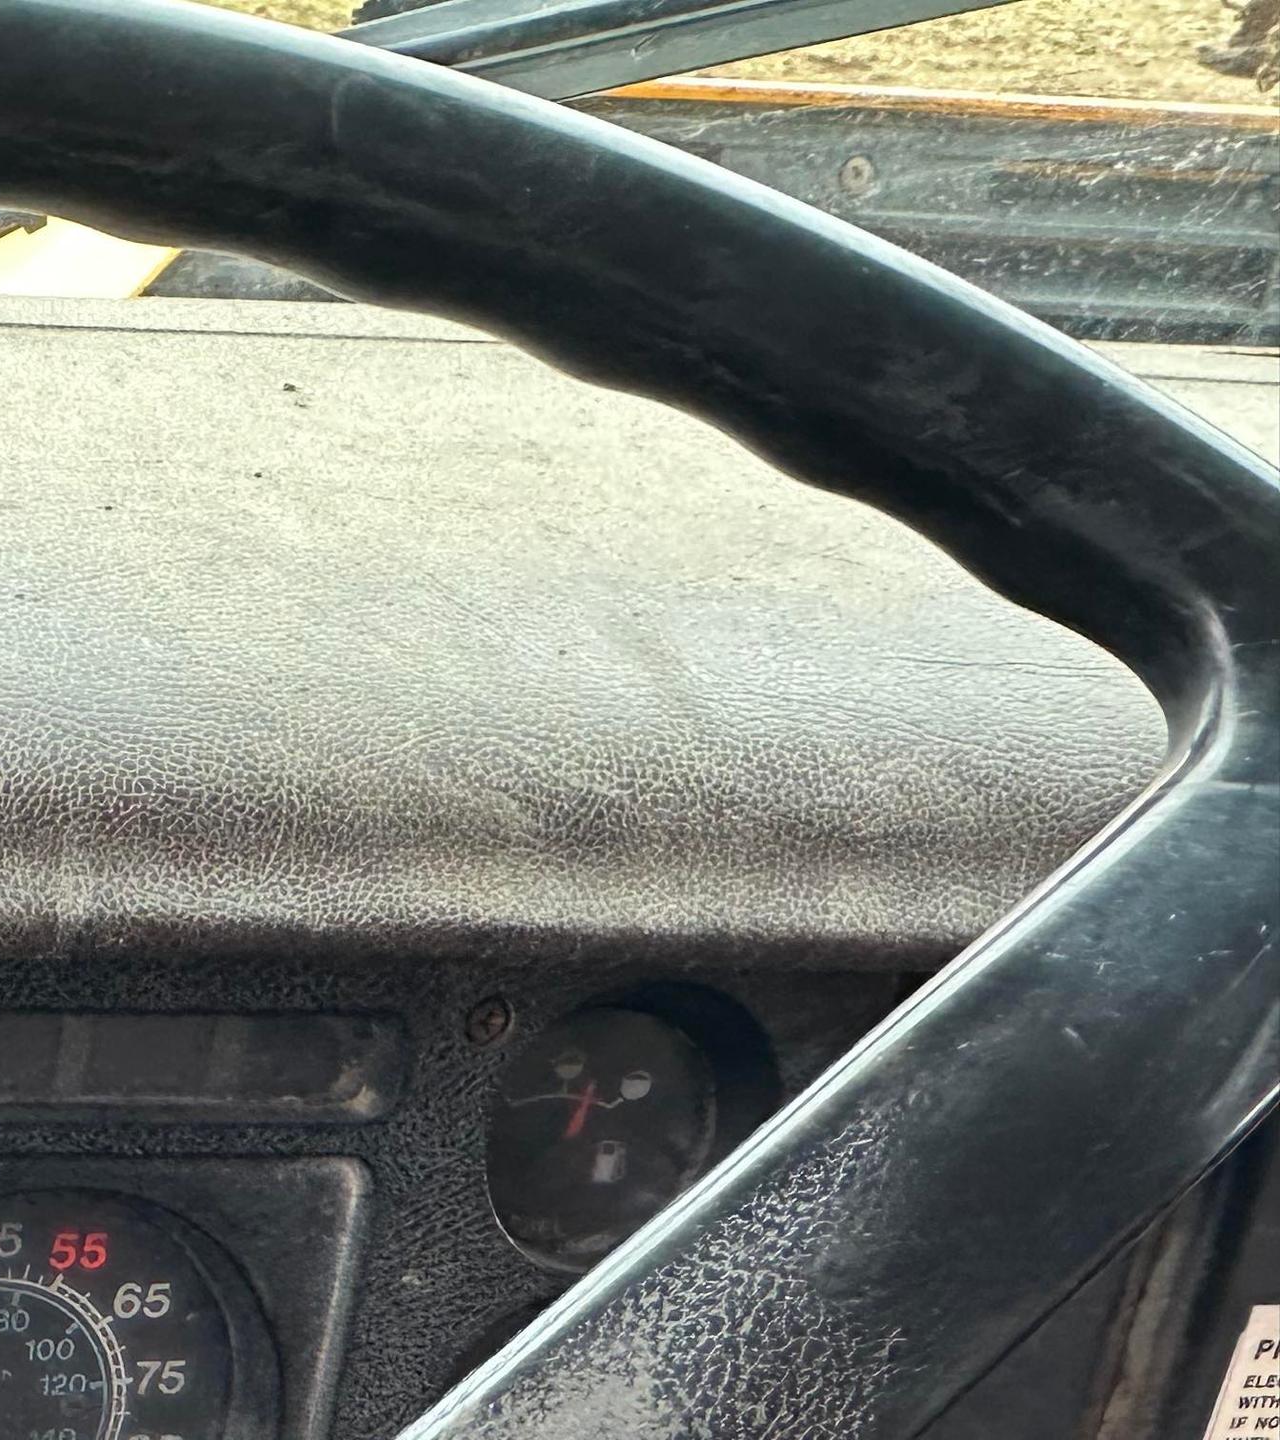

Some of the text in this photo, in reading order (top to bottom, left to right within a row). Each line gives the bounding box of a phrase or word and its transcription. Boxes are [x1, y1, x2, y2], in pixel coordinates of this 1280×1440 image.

[49, 1232, 108, 1270] 55
[113, 1282, 171, 1319] 65
[25, 1338, 76, 1362] 100
[40, 1374, 87, 1396] 120
[136, 1360, 186, 1395] 75
[1229, 1416, 1248, 1430] IF
